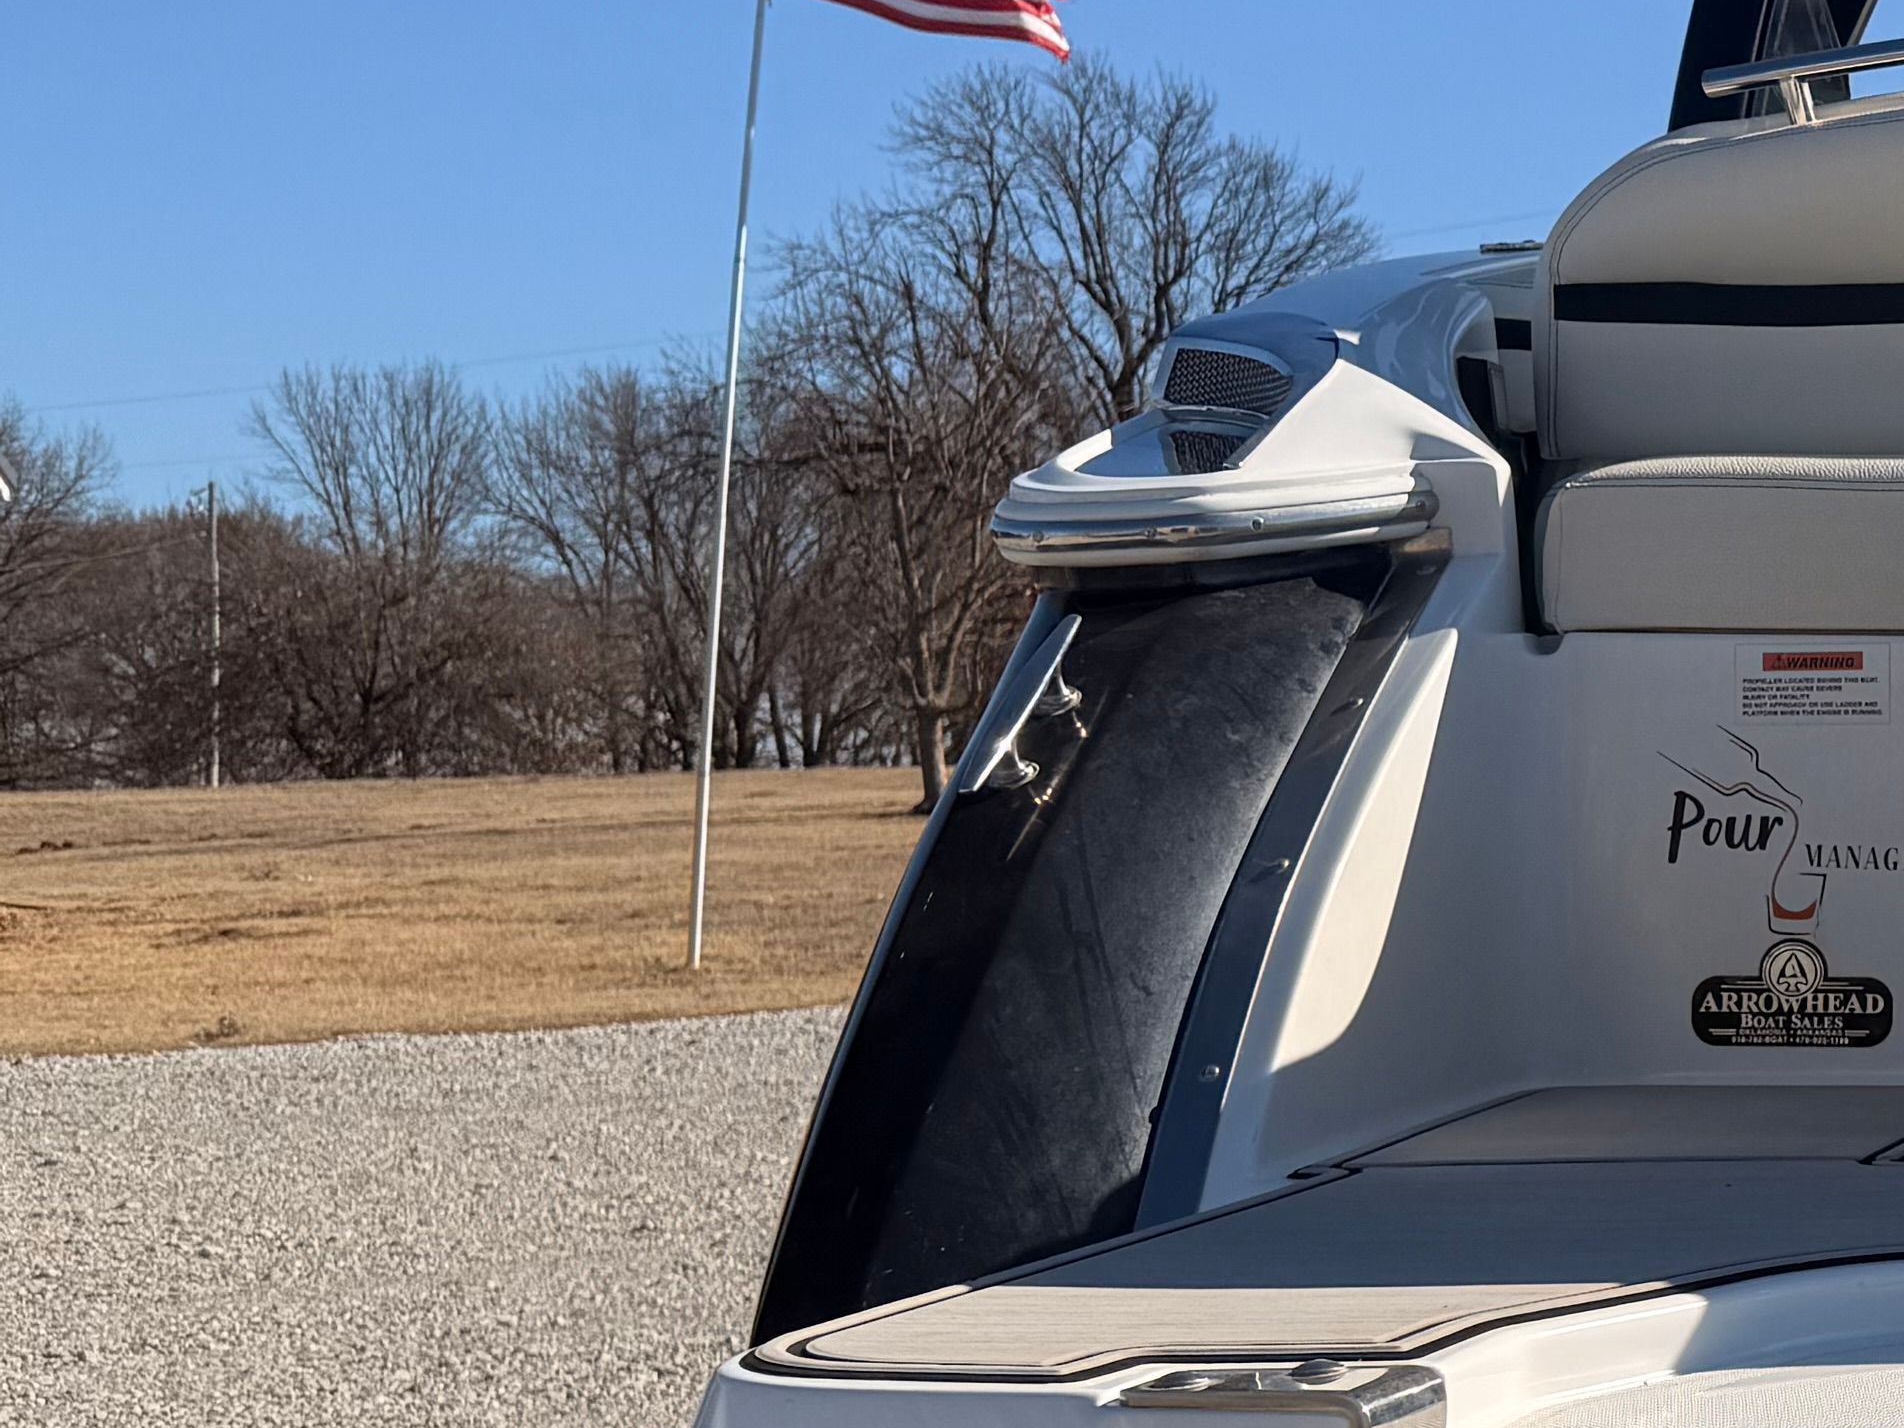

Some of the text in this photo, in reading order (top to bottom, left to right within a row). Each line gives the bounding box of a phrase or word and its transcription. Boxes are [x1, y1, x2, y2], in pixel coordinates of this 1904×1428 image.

[1786, 656, 1856, 669] WARNING
[1666, 789, 1784, 864] Pour
[1699, 991, 1885, 1014] ARROWHEAD
[1739, 1028, 1842, 1037] OKLAHOMA ARKANSAS
